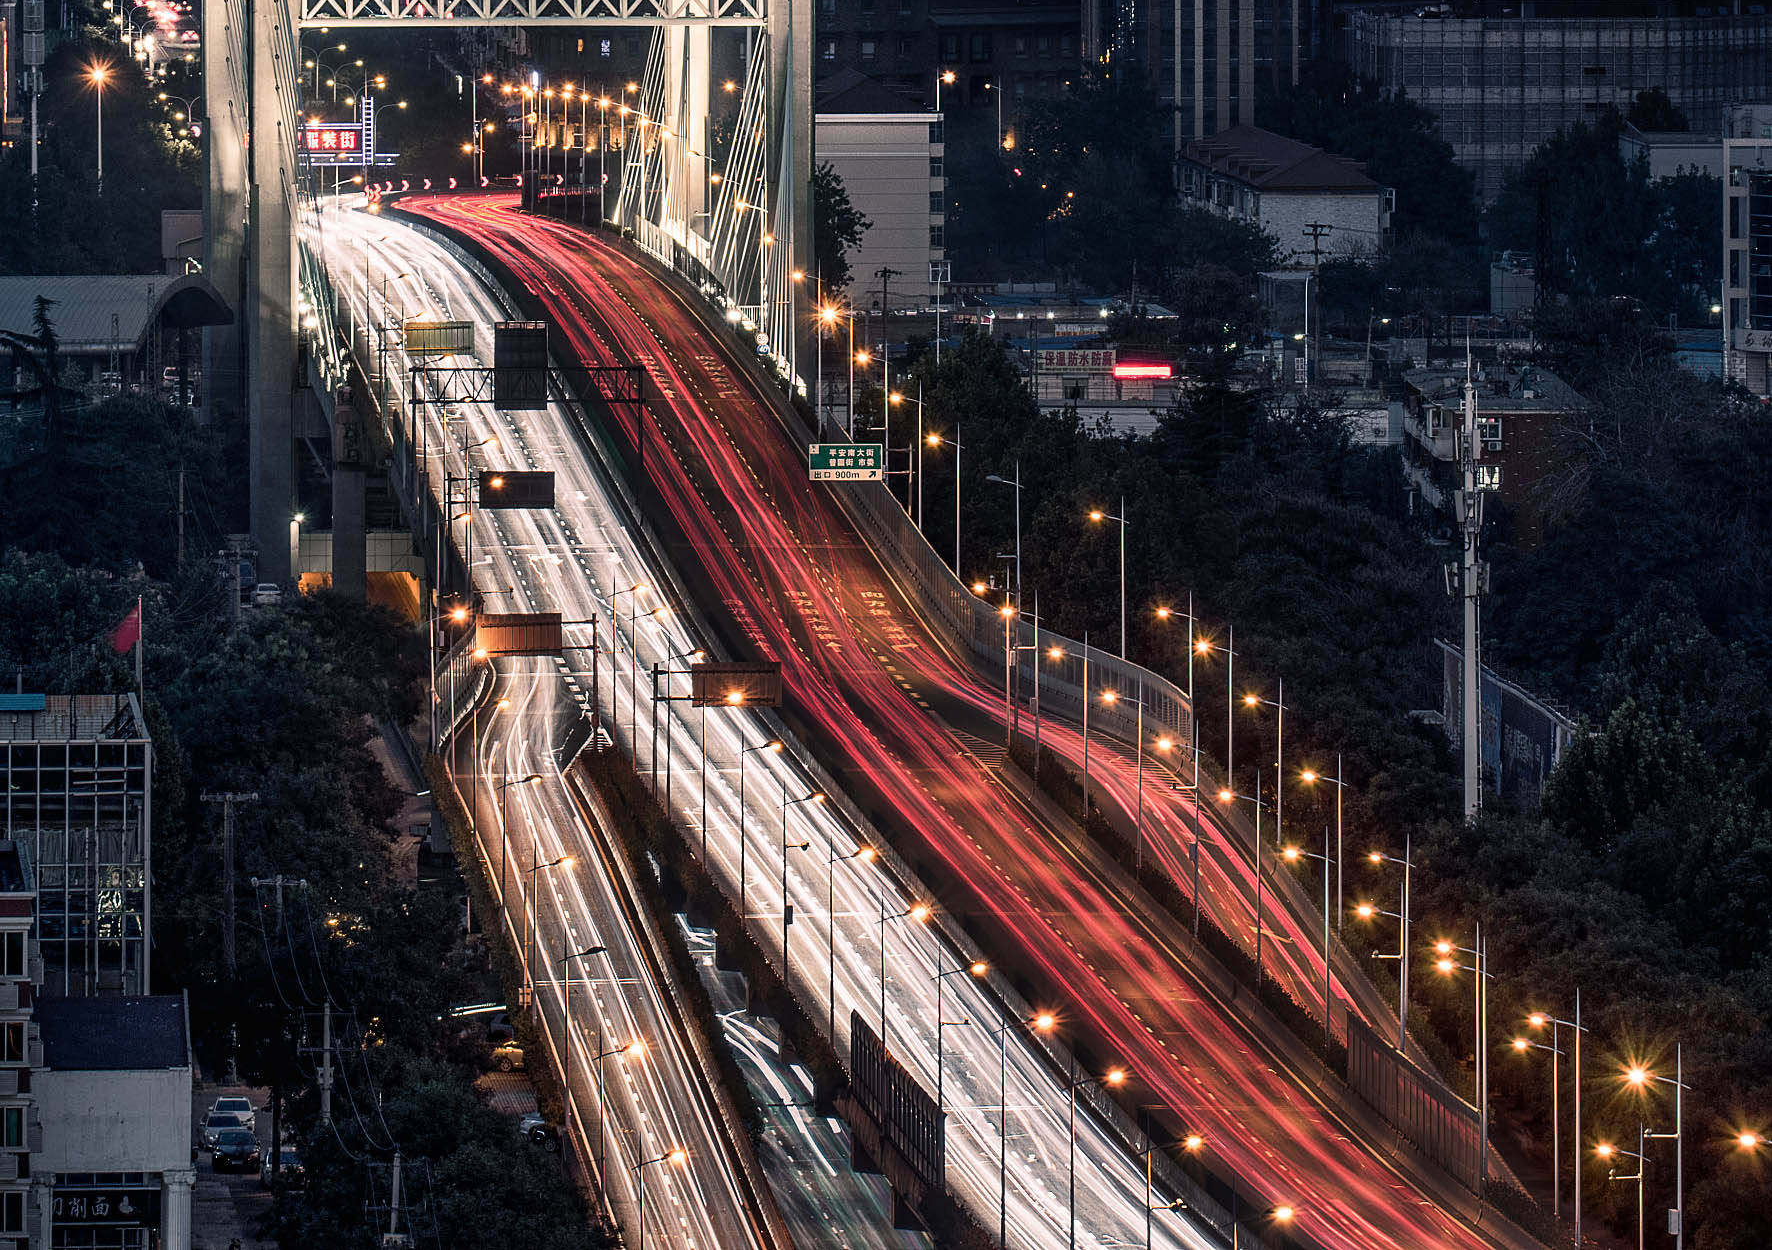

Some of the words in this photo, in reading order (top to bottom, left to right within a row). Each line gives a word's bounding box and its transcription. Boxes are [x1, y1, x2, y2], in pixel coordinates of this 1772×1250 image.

[829, 448, 874, 457] 平安南大街
[814, 471, 831, 479] 出口
[835, 471, 860, 479] 900m
